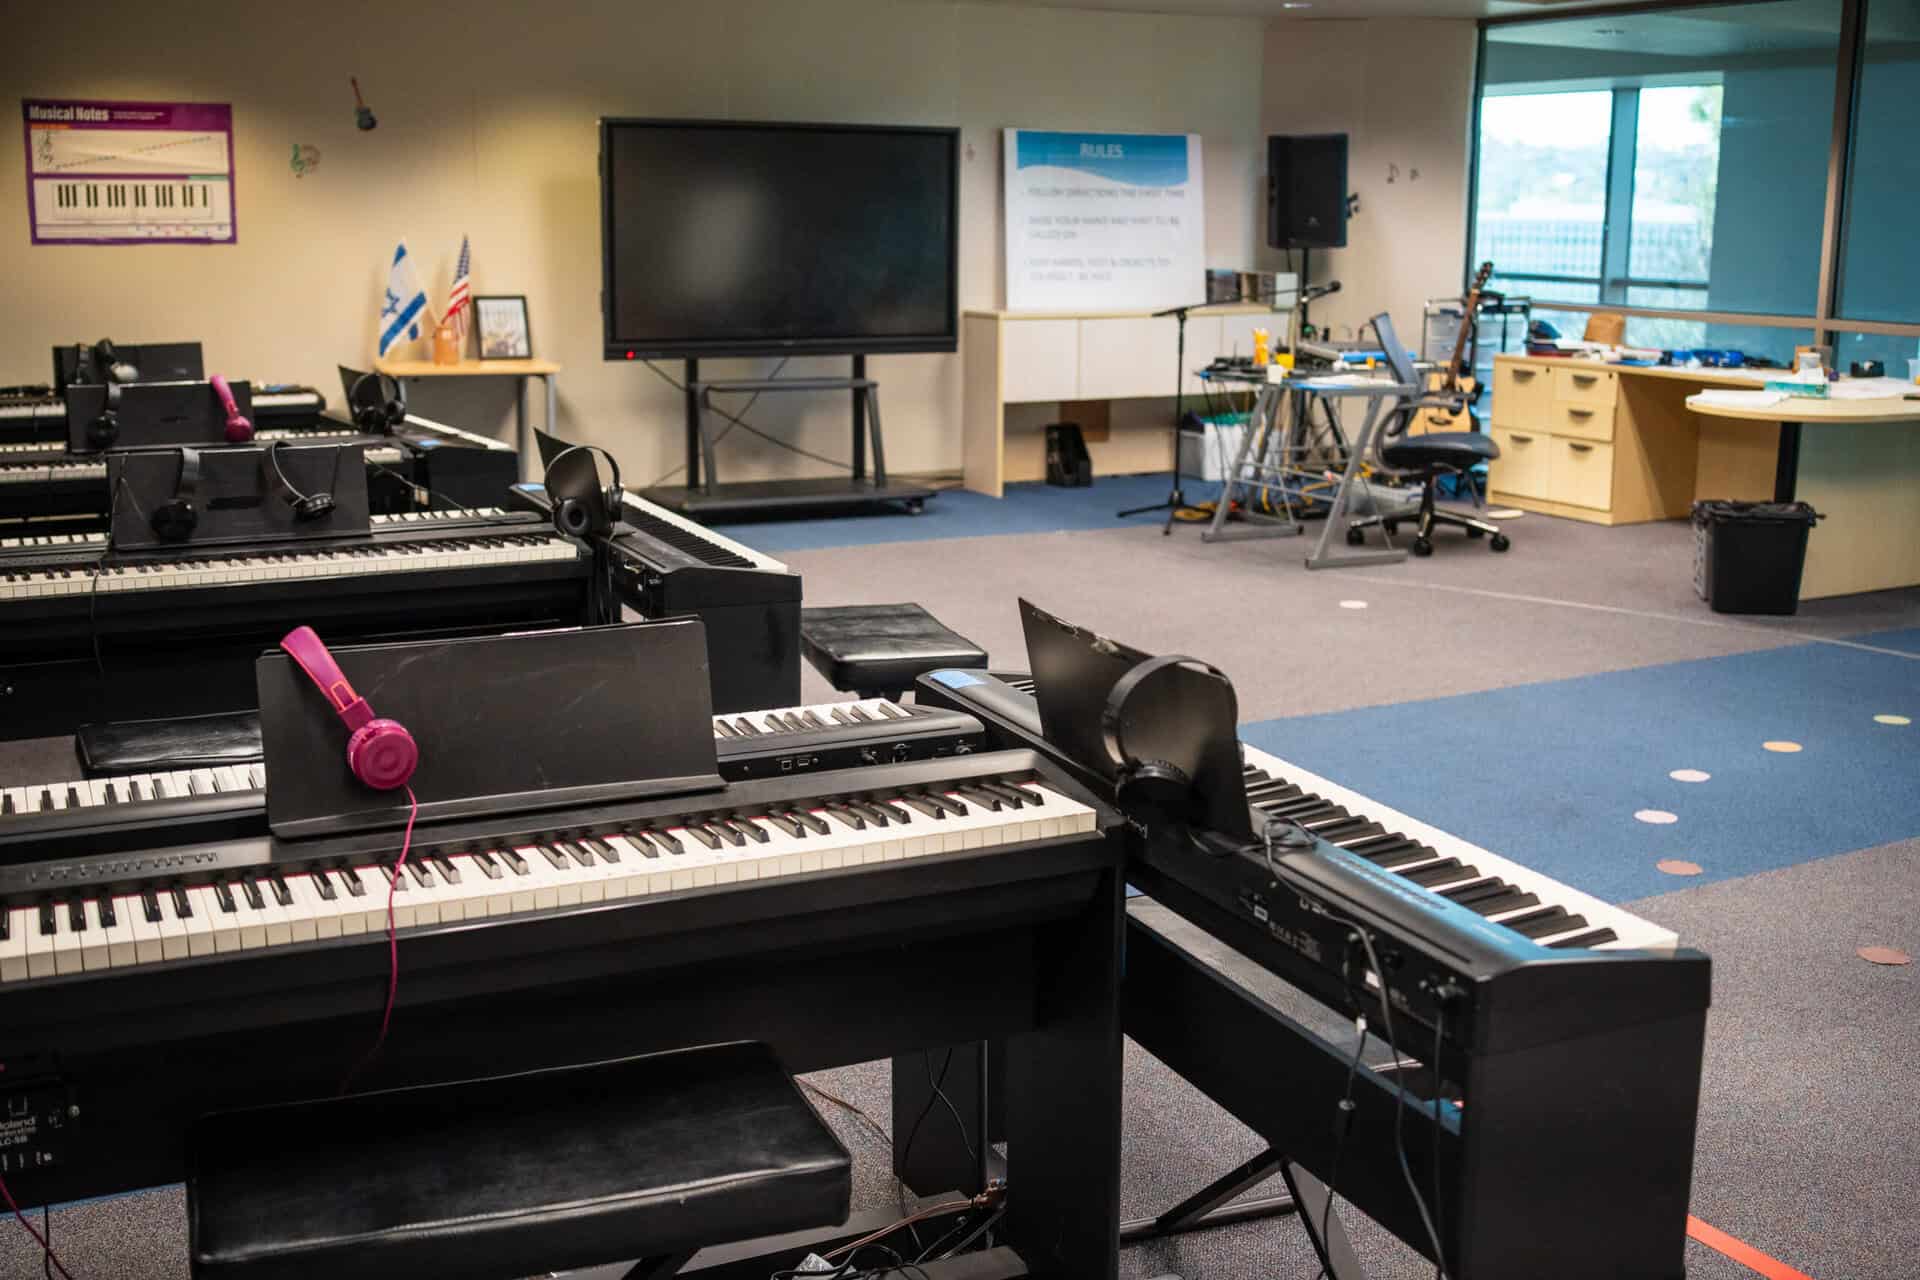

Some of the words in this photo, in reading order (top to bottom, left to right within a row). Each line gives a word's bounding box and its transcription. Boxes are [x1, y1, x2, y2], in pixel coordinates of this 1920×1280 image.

[29, 106, 74, 121] Musical
[76, 107, 110, 121] Notes
[1079, 143, 1124, 159] RULES
